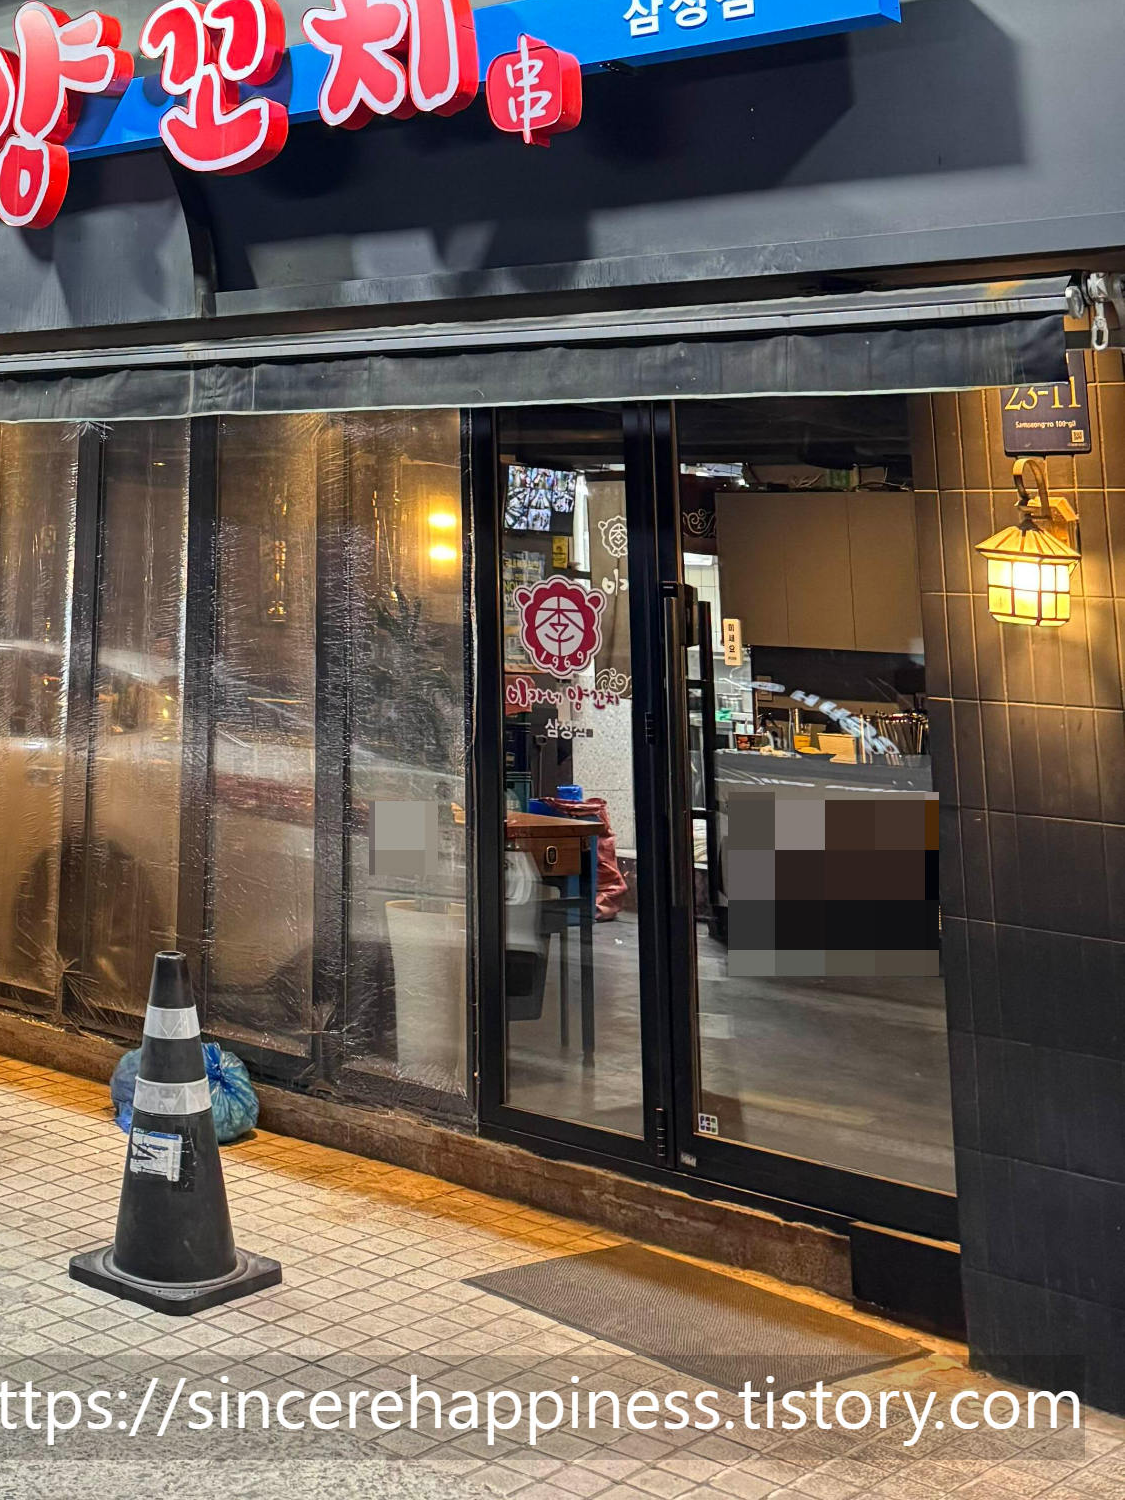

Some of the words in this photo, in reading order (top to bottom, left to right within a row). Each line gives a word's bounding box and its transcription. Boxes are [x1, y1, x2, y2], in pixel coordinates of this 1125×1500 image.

[1004, 376, 1081, 410] 23-11
[539, 650, 585, 669] 1969
[506, 678, 563, 707] 이가네
[566, 684, 620, 712] 양꼬치
